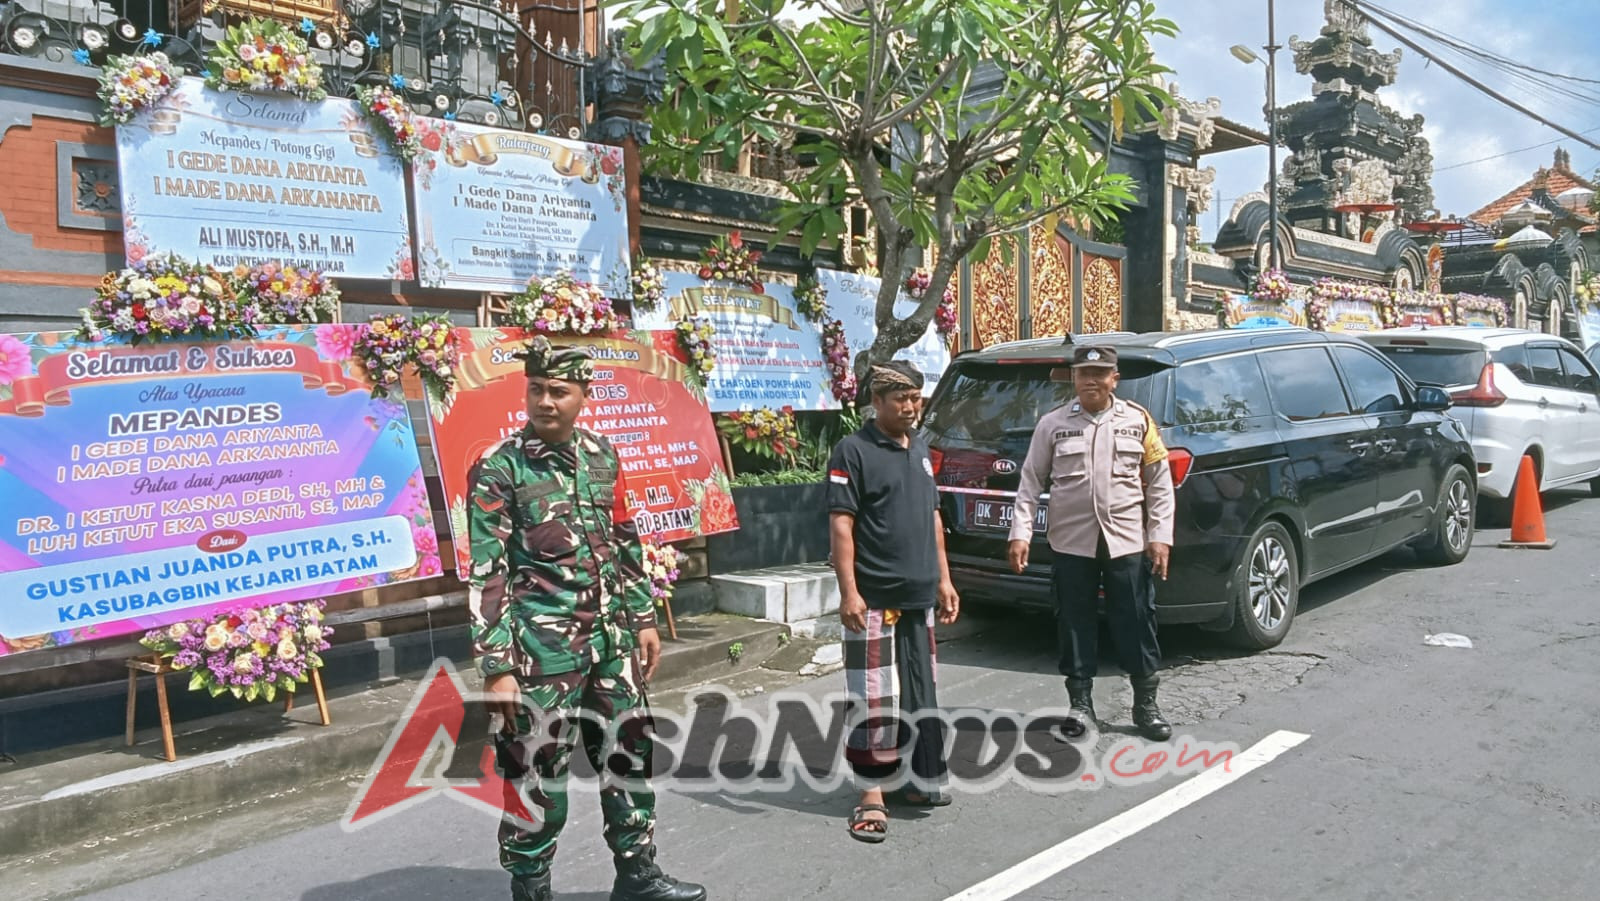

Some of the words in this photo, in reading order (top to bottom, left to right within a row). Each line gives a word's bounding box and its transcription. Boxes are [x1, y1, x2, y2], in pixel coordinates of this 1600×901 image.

[225, 91, 308, 123] Selamat
[200, 130, 261, 151] Mepandes
[271, 138, 312, 158] Potong
[313, 144, 336, 161] Gigi
[167, 150, 175, 168] I
[178, 151, 228, 173] GEDE
[231, 156, 281, 178] DANA
[286, 160, 368, 186] ARIYANTA
[153, 176, 161, 195] I
[165, 179, 222, 200] MADE
[225, 182, 275, 204] DANA
[280, 187, 383, 213] ARKANANTA
[458, 184, 464, 194] I
[469, 185, 500, 199] Gede
[506, 189, 537, 203] Dana
[542, 193, 591, 209] Ariyanta
[453, 196, 459, 207] I
[464, 197, 498, 211] Made
[502, 201, 533, 215] Dana
[539, 206, 597, 222] Arkananta
[200, 227, 222, 246] ALI
[226, 229, 295, 254] MUSTOFA,
[213, 255, 234, 267] KASI
[316, 260, 345, 272] KUKAR
[472, 245, 507, 260] Bangkit
[510, 249, 544, 262] Sormin,
[702, 295, 762, 309] SELAMAT
[67, 347, 178, 378] Selamat
[187, 346, 207, 369] &
[214, 346, 296, 369] Sukses
[590, 347, 640, 361] Sukses
[139, 384, 180, 404] Atas
[184, 382, 246, 404] Upacara
[714, 389, 759, 400] EASTERN
[761, 389, 807, 400] INDONESIA
[766, 379, 812, 390] POKPHAND
[110, 403, 282, 436] MEPANDES
[595, 402, 656, 417] ARIYANTA
[593, 416, 668, 431] ARKANANTA
[1113, 428, 1141, 439] POLRI
[71, 443, 79, 462] I
[85, 436, 147, 460] GEDE
[154, 431, 217, 455] DANA
[222, 424, 323, 446] ARIYANTA
[609, 431, 643, 444] sangan
[646, 444, 666, 455] SH,
[668, 442, 687, 452] MH
[689, 441, 698, 450] &
[57, 465, 66, 483] I
[72, 457, 142, 481] MADE
[147, 451, 213, 474] DANA
[217, 440, 339, 466] ARKANANTA
[621, 460, 652, 472] ANTI,
[654, 457, 672, 469] SE,
[673, 454, 699, 466] MAP
[995, 462, 1012, 471] KIA
[130, 474, 179, 496] Putra
[184, 471, 214, 490] dari
[217, 467, 283, 492] pasangan
[17, 517, 59, 536] DR.
[66, 514, 75, 529] I
[81, 503, 155, 527] KETUT
[161, 494, 236, 518] KASNA
[242, 486, 295, 511] DEDI,
[299, 482, 331, 500] SH,
[336, 477, 366, 495] MH
[371, 476, 386, 491] &
[646, 485, 675, 505] M.H.
[653, 508, 693, 532] BATAM
[977, 503, 992, 518] DK
[27, 532, 77, 555] LUH
[83, 523, 156, 548] KETUT
[164, 516, 207, 537] EKA
[212, 503, 306, 531] SUSANTI,
[311, 498, 338, 518] SE,
[342, 494, 383, 513] MAP
[26, 566, 151, 601] GUSTIAN
[157, 550, 262, 582] JUANDA
[267, 538, 348, 563] PUTRA,
[352, 529, 392, 549] S.H.
[58, 584, 222, 623] KASUBAGBIN
[226, 568, 302, 594] KEJARI
[308, 555, 379, 579] BATAM
